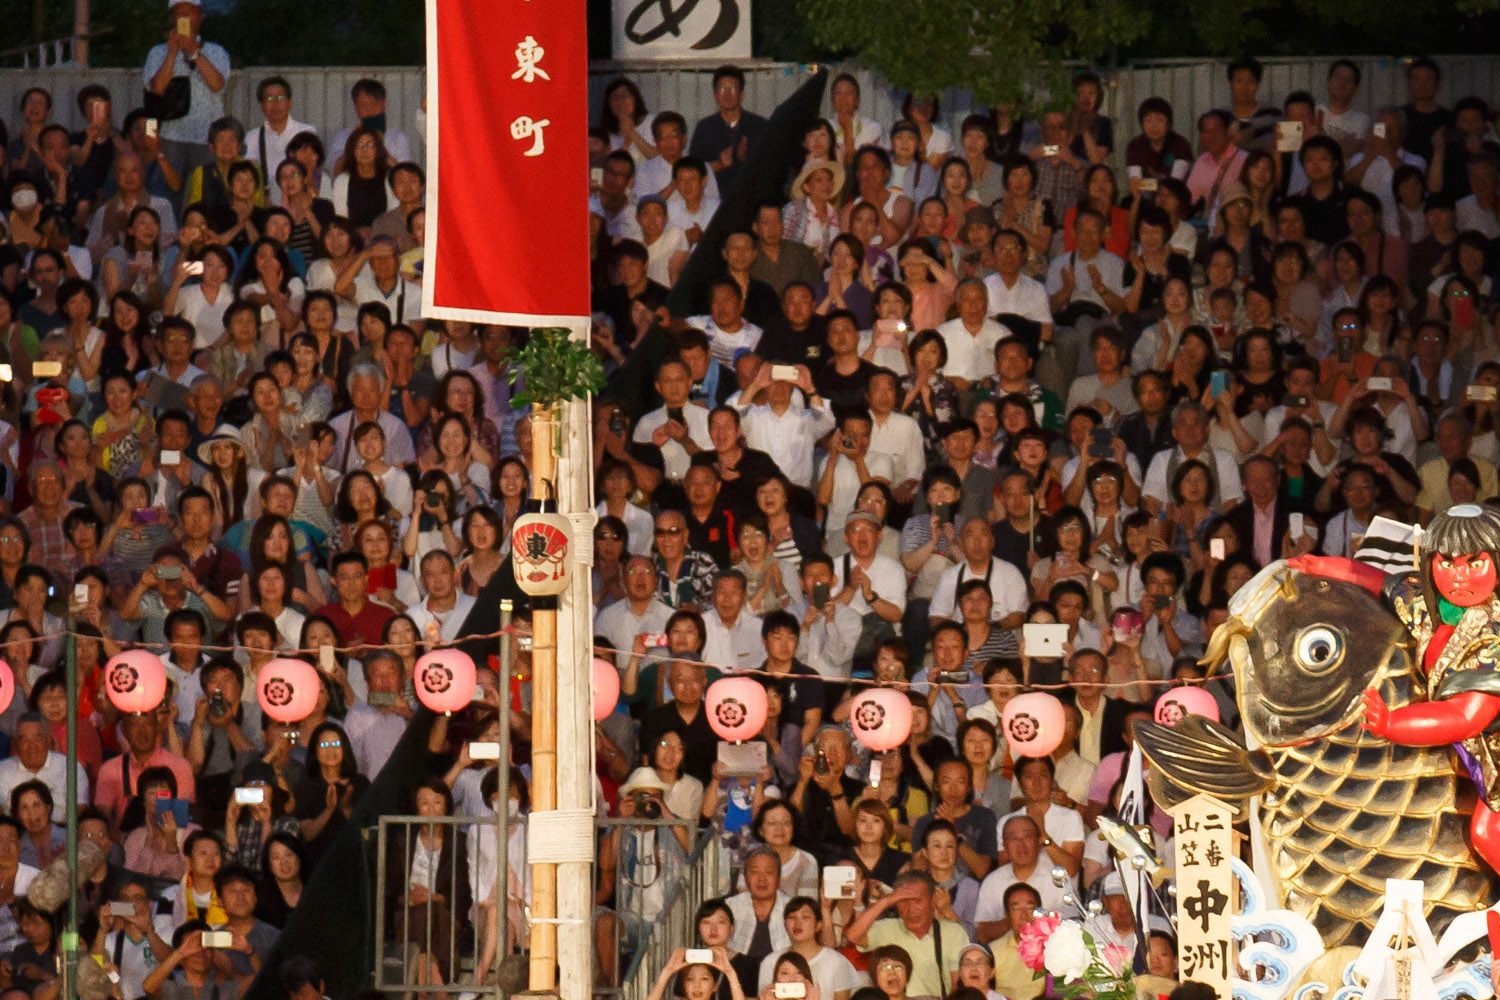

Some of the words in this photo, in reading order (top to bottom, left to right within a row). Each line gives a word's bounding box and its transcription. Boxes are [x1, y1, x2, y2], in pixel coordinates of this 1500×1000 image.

[511, 0, 551, 157] 東町
[526, 532, 550, 560] 東
[1177, 813, 1200, 868] 山笠
[1203, 813, 1225, 868] 二番
